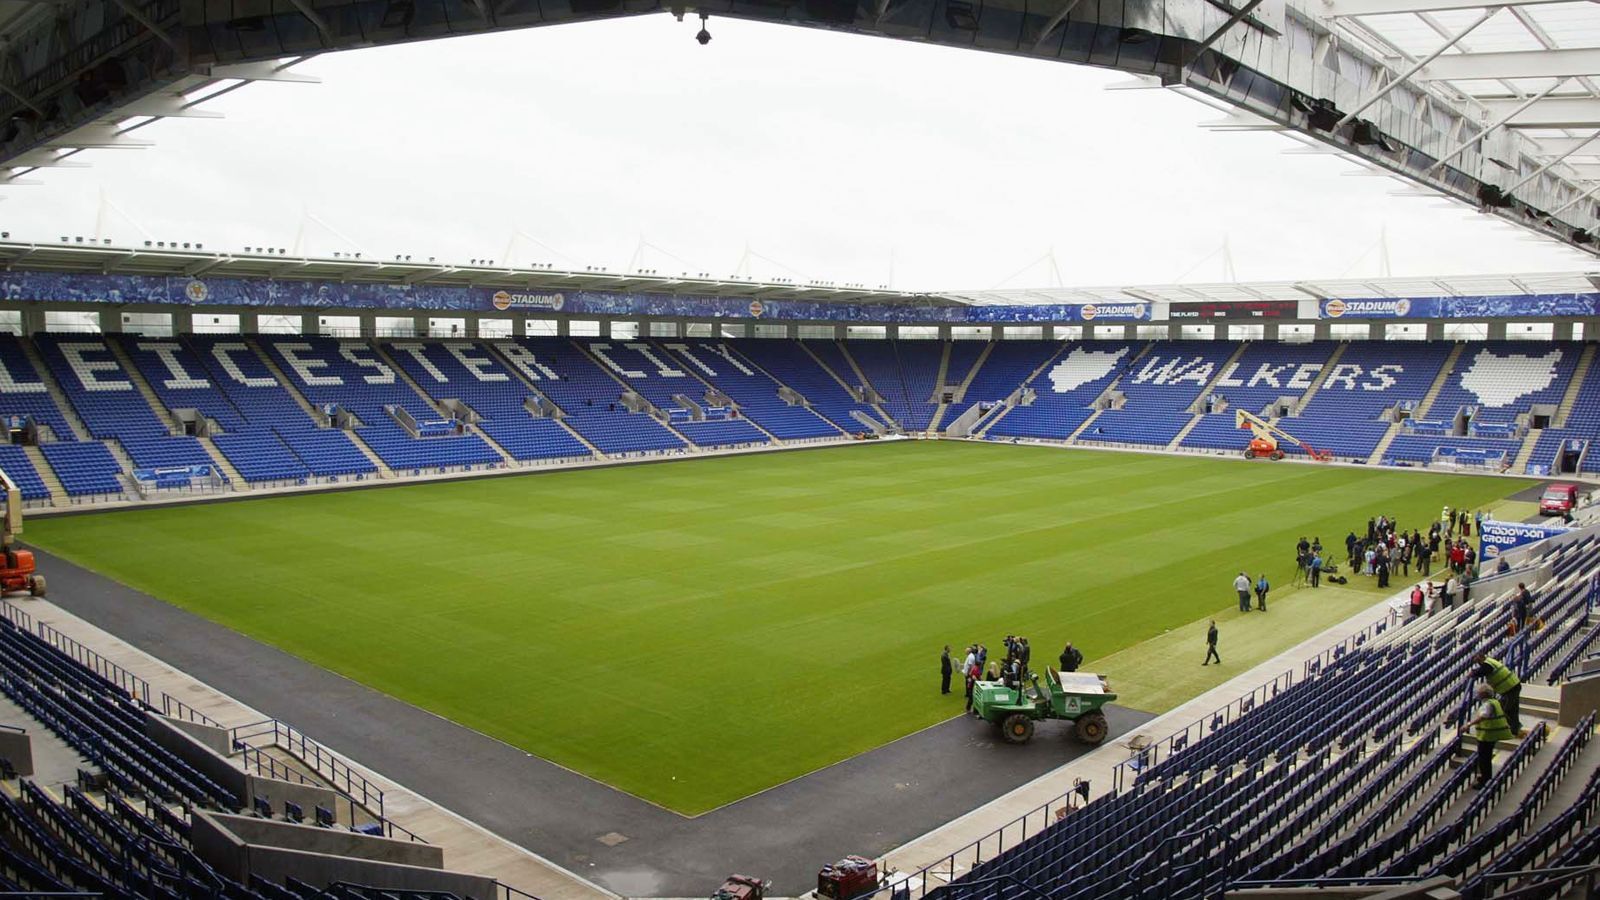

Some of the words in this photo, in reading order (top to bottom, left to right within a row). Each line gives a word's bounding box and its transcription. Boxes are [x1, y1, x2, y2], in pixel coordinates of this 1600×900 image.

[511, 294, 553, 305] STADIUM
[1096, 306, 1135, 315] STADIUM
[1345, 301, 1396, 311] STADIUM
[0, 342, 559, 393] LEICESTER
[589, 342, 754, 378] CITY
[1131, 356, 1404, 391] WALKERS
[1482, 525, 1545, 539] WIDDOWSON
[1481, 534, 1516, 545] GROUP
